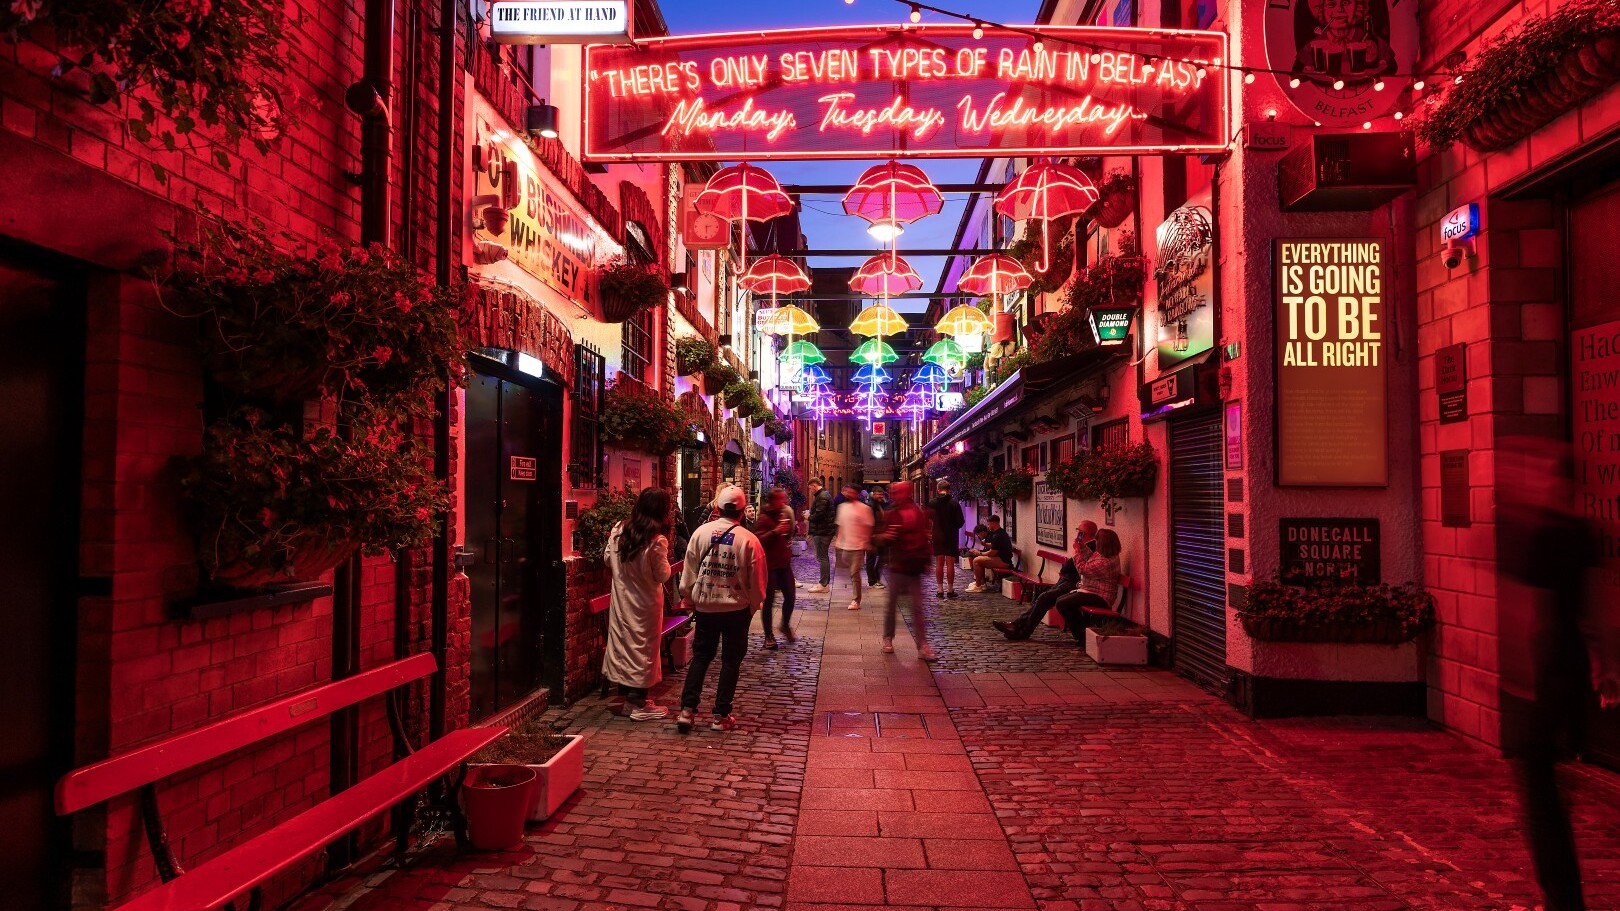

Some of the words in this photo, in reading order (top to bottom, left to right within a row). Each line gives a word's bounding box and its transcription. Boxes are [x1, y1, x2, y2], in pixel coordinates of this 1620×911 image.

[497, 7, 520, 21] THE
[523, 7, 565, 21] FRIEND
[567, 7, 581, 21] AT
[585, 7, 616, 21] HAND
[711, 54, 768, 86] ONLY
[781, 49, 858, 81] SEVEN
[869, 48, 946, 78] TYPES
[956, 48, 988, 77] OF
[998, 48, 1057, 80] RAIN
[1066, 50, 1090, 81] IN
[1313, 98, 1374, 118] BELFAST
[1253, 133, 1286, 145] focus
[1444, 221, 1466, 240] focus
[510, 212, 579, 293] WHISKEY
[1281, 242, 1380, 264] EVERYTHING
[1281, 264, 1304, 295] IS
[1309, 264, 1381, 295] GOING
[1098, 320, 1129, 328] DIAMOND
[1101, 313, 1127, 321] DOUBLE
[1282, 295, 1327, 340] TO
[1338, 296, 1381, 340] BE
[1283, 341, 1318, 367] ALL
[1322, 341, 1381, 367] RIGHT
[1580, 398, 1618, 423] The
[1581, 428, 1604, 453] Of
[1582, 459, 1588, 485] I
[1288, 526, 1373, 542] DONEGALL
[1300, 544, 1362, 560] SQUARE
[1305, 561, 1359, 577] NORH
